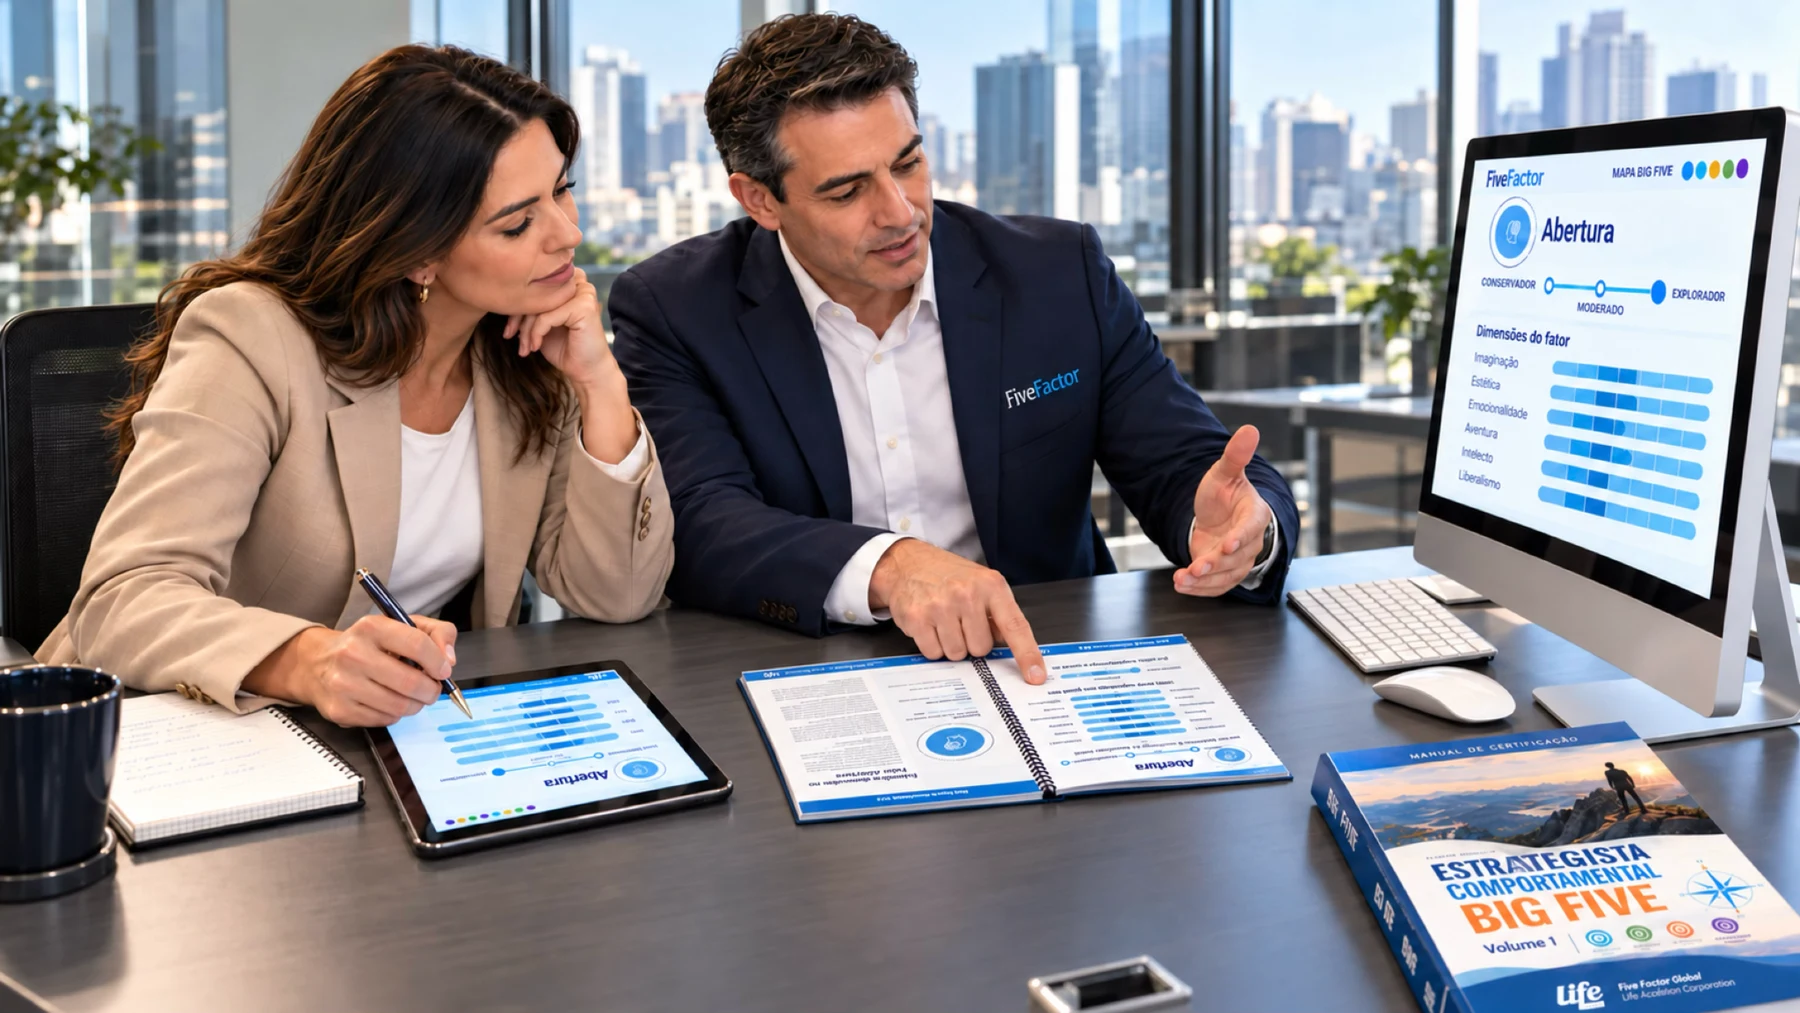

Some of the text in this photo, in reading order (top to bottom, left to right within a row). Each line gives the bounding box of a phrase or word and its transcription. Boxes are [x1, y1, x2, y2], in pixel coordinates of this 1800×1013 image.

[1486, 169, 1544, 188] FiveFactor
[1612, 165, 1673, 178] MAPA BIG FIVE
[1541, 216, 1615, 243] Abertura
[1481, 277, 1536, 290] CONSERVADOR
[1672, 288, 1726, 302] EXPLORADOR
[1577, 302, 1624, 315] MODERADO
[1476, 324, 1570, 348] Dimensões do fator
[1474, 352, 1519, 369] Imaginação
[1005, 368, 1080, 409] FiveFactor
[1471, 375, 1501, 391] Estética
[1468, 398, 1528, 420] Emocionalidade
[1464, 422, 1498, 440] Aventura
[1461, 446, 1494, 464] Intelecto
[1458, 469, 1501, 490] Liberalismo
[1489, 736, 1578, 751] CERTIFICAÇÃO
[1135, 758, 1195, 771] Abertura
[544, 769, 609, 788] Abertura
[1430, 843, 1652, 882] ESTRATEGISTA
[1446, 863, 1662, 901] COMPORTAMENTAL
[1460, 884, 1668, 934] BIG FIVE
[1483, 936, 1557, 954] Volume 1
[1617, 971, 1702, 992] Five Factor Global
[1682, 979, 1736, 994] Corporation
